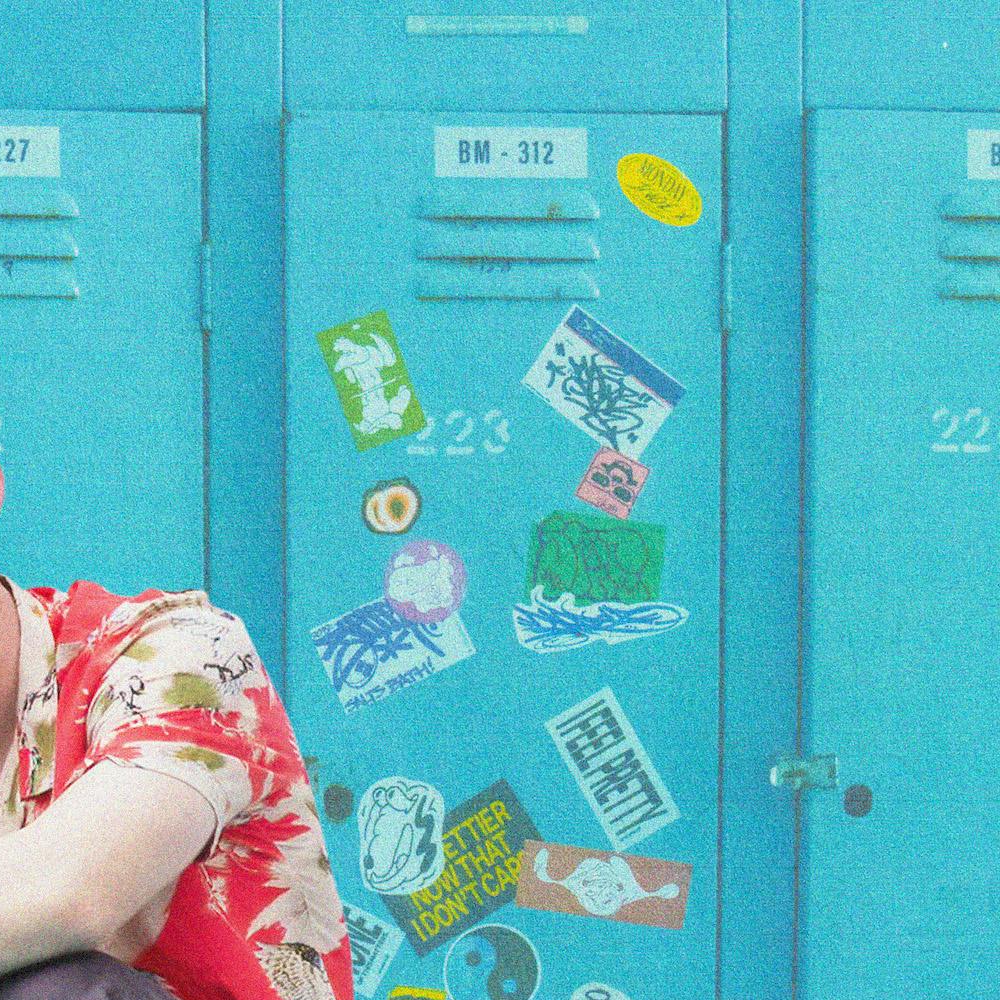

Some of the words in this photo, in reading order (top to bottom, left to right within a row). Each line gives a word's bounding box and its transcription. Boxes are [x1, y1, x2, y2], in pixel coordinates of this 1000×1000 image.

[457, 139, 490, 164] BM
[518, 140, 554, 165] 312
[406, 408, 511, 455] 223
[554, 698, 609, 731] I
[559, 705, 634, 773] FEEL
[583, 747, 669, 837] PRETTY
[442, 800, 513, 860] ETTIER
[453, 829, 513, 880] THAT
[411, 920, 428, 942] I
[419, 880, 486, 936] DON'T
